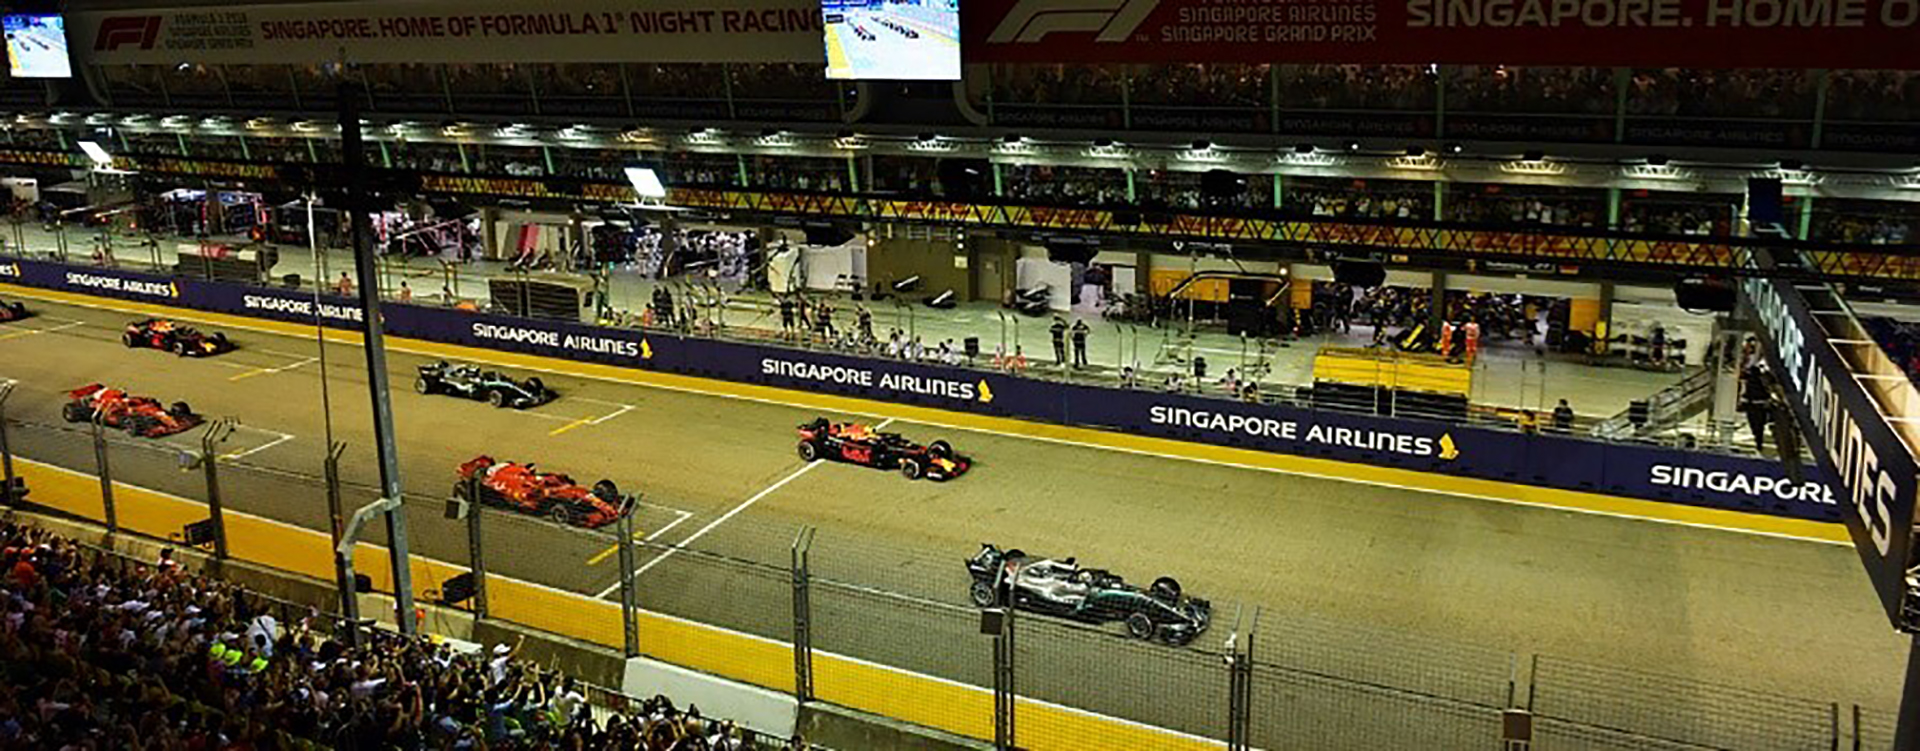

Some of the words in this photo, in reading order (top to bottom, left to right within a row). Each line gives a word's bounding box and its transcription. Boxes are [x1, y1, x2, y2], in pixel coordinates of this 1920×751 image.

[260, 18, 378, 40] SINGAPORE.
[380, 16, 445, 38] HOME
[448, 15, 476, 37] OF
[480, 13, 600, 37] FORMULA
[630, 11, 715, 34] NIGHT
[1180, 6, 1283, 23] SINGAPORE
[1288, 5, 1377, 22] AIRLINES
[1406, 0, 1693, 28] SINGAPORE.
[1706, 0, 1865, 28] HOME
[1161, 26, 1259, 42] SINGAPORE
[1264, 25, 1328, 42] GRAND
[1332, 25, 1377, 42] PRIX
[243, 295, 312, 315] SINGAPORE
[315, 303, 364, 322] AIRLINE
[472, 322, 559, 346] SINGAPORE
[563, 334, 638, 357] AIRLINES
[761, 358, 873, 386] SINGAPORE
[880, 373, 974, 399] AIRLINES
[1150, 405, 1298, 440] SINGAPORE
[1305, 424, 1433, 456] AIRLINES
[1804, 353, 1897, 557] AIRLINES
